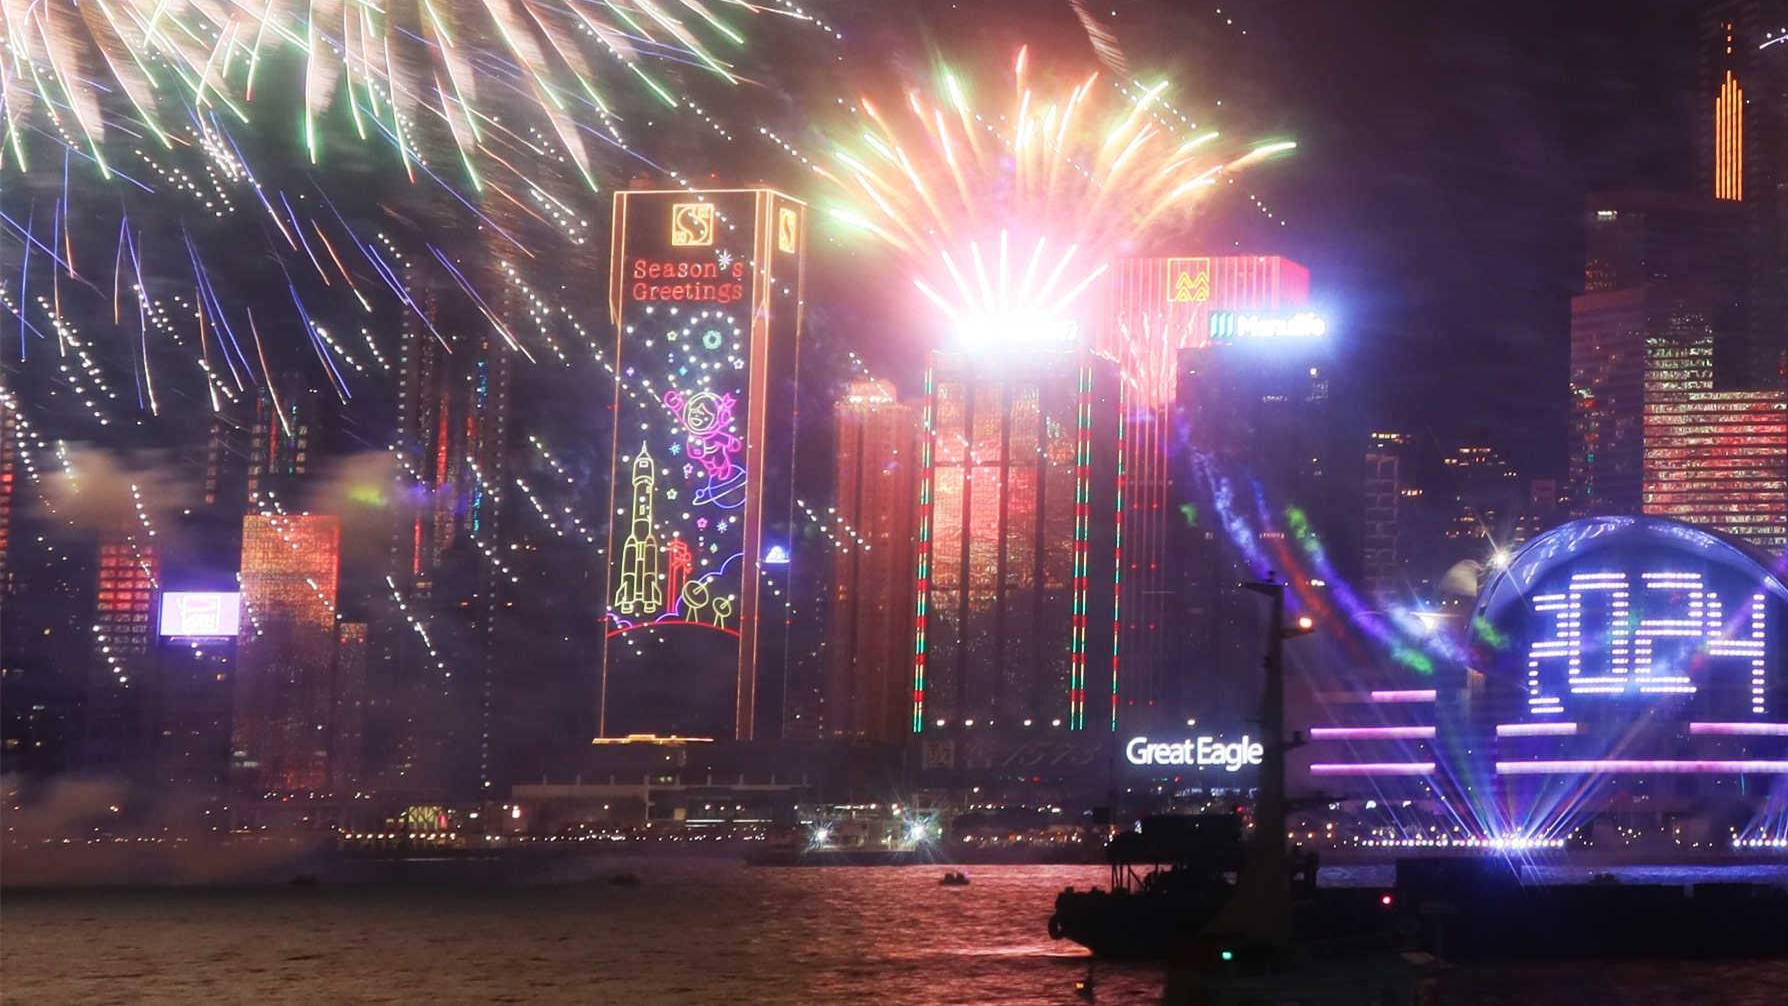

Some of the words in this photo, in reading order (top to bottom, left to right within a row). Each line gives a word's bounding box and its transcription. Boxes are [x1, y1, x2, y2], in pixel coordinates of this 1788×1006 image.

[633, 281, 743, 303] Greetings
[1528, 573, 1765, 713] 2024
[1126, 736, 1195, 765] Great
[1196, 735, 1264, 772] Eagle
